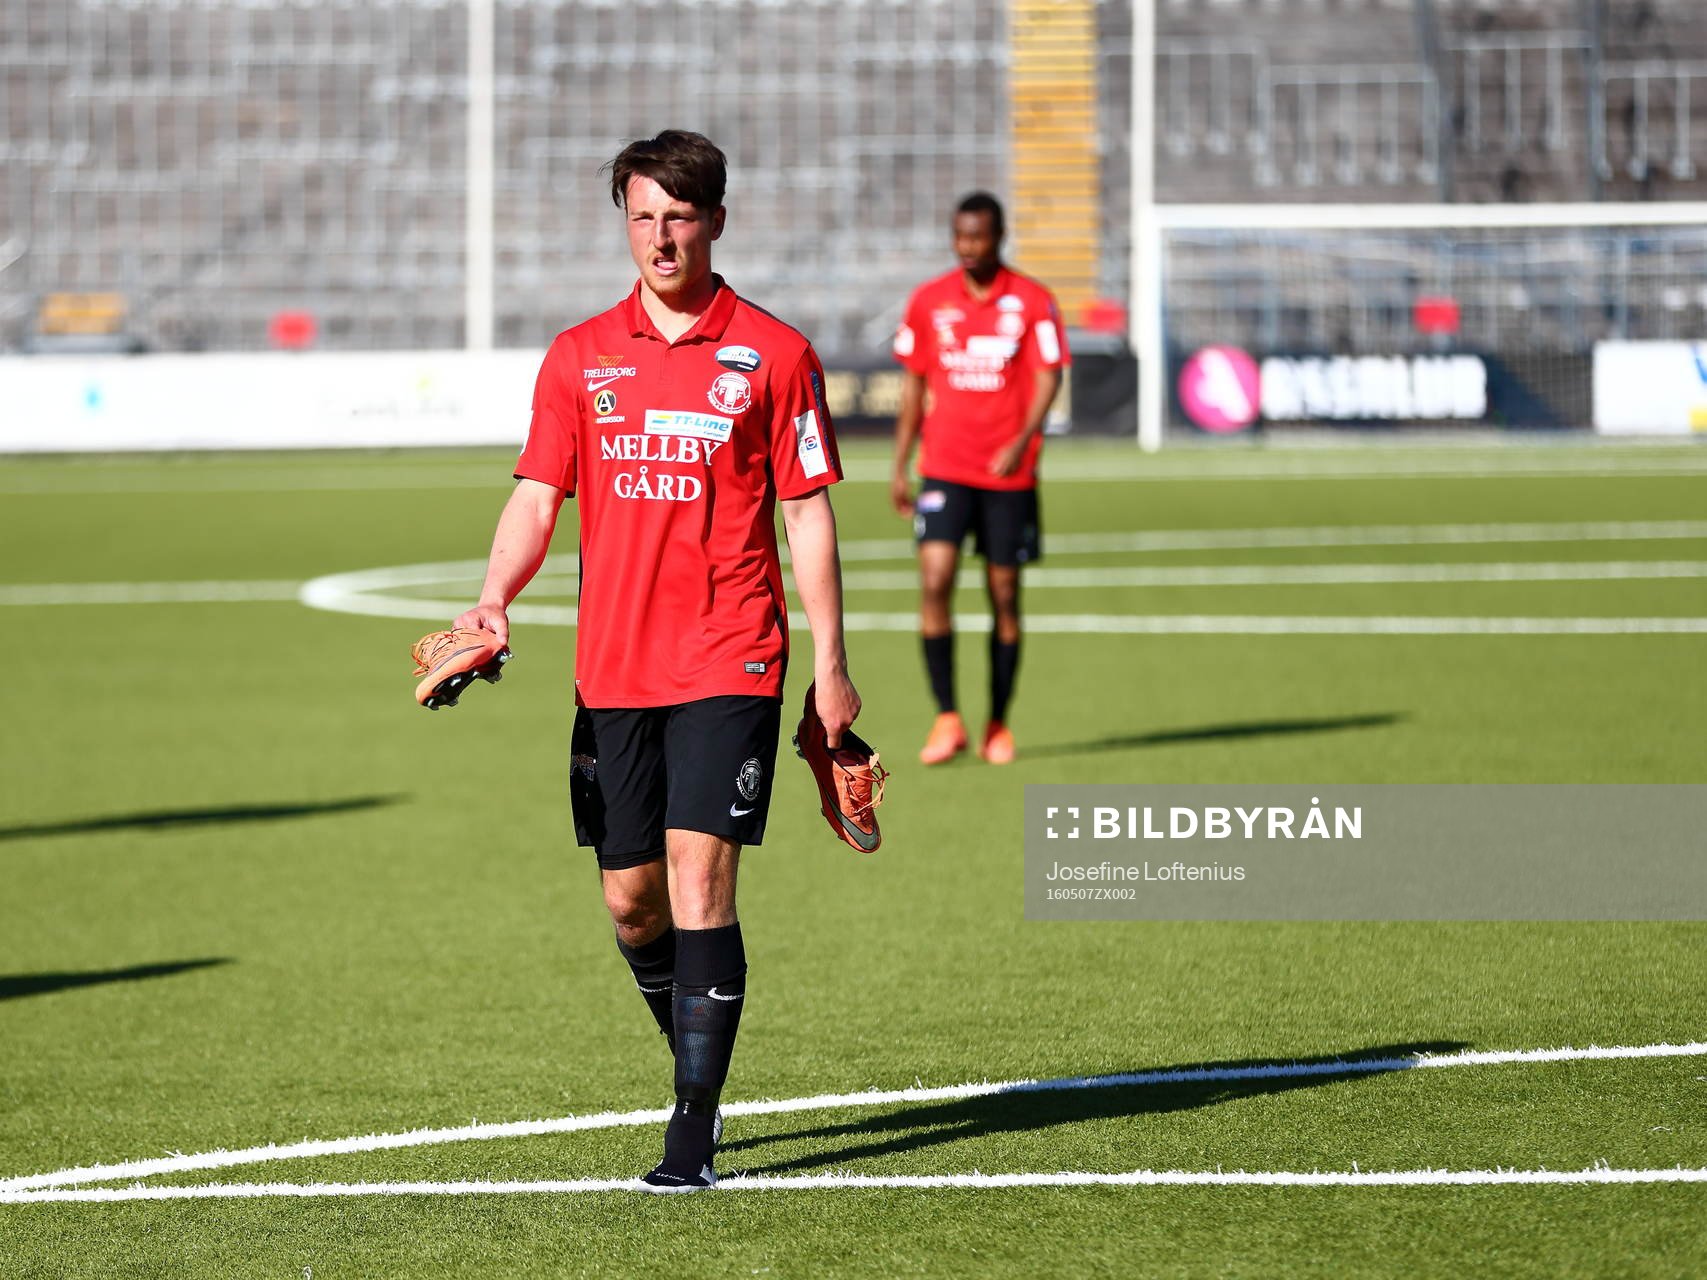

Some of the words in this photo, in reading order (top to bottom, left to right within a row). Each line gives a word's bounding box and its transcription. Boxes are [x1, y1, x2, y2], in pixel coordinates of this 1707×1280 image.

[583, 367, 636, 379] TRELLEBORG
[601, 434, 723, 466] MELLBY
[614, 465, 702, 502] GÅRD
